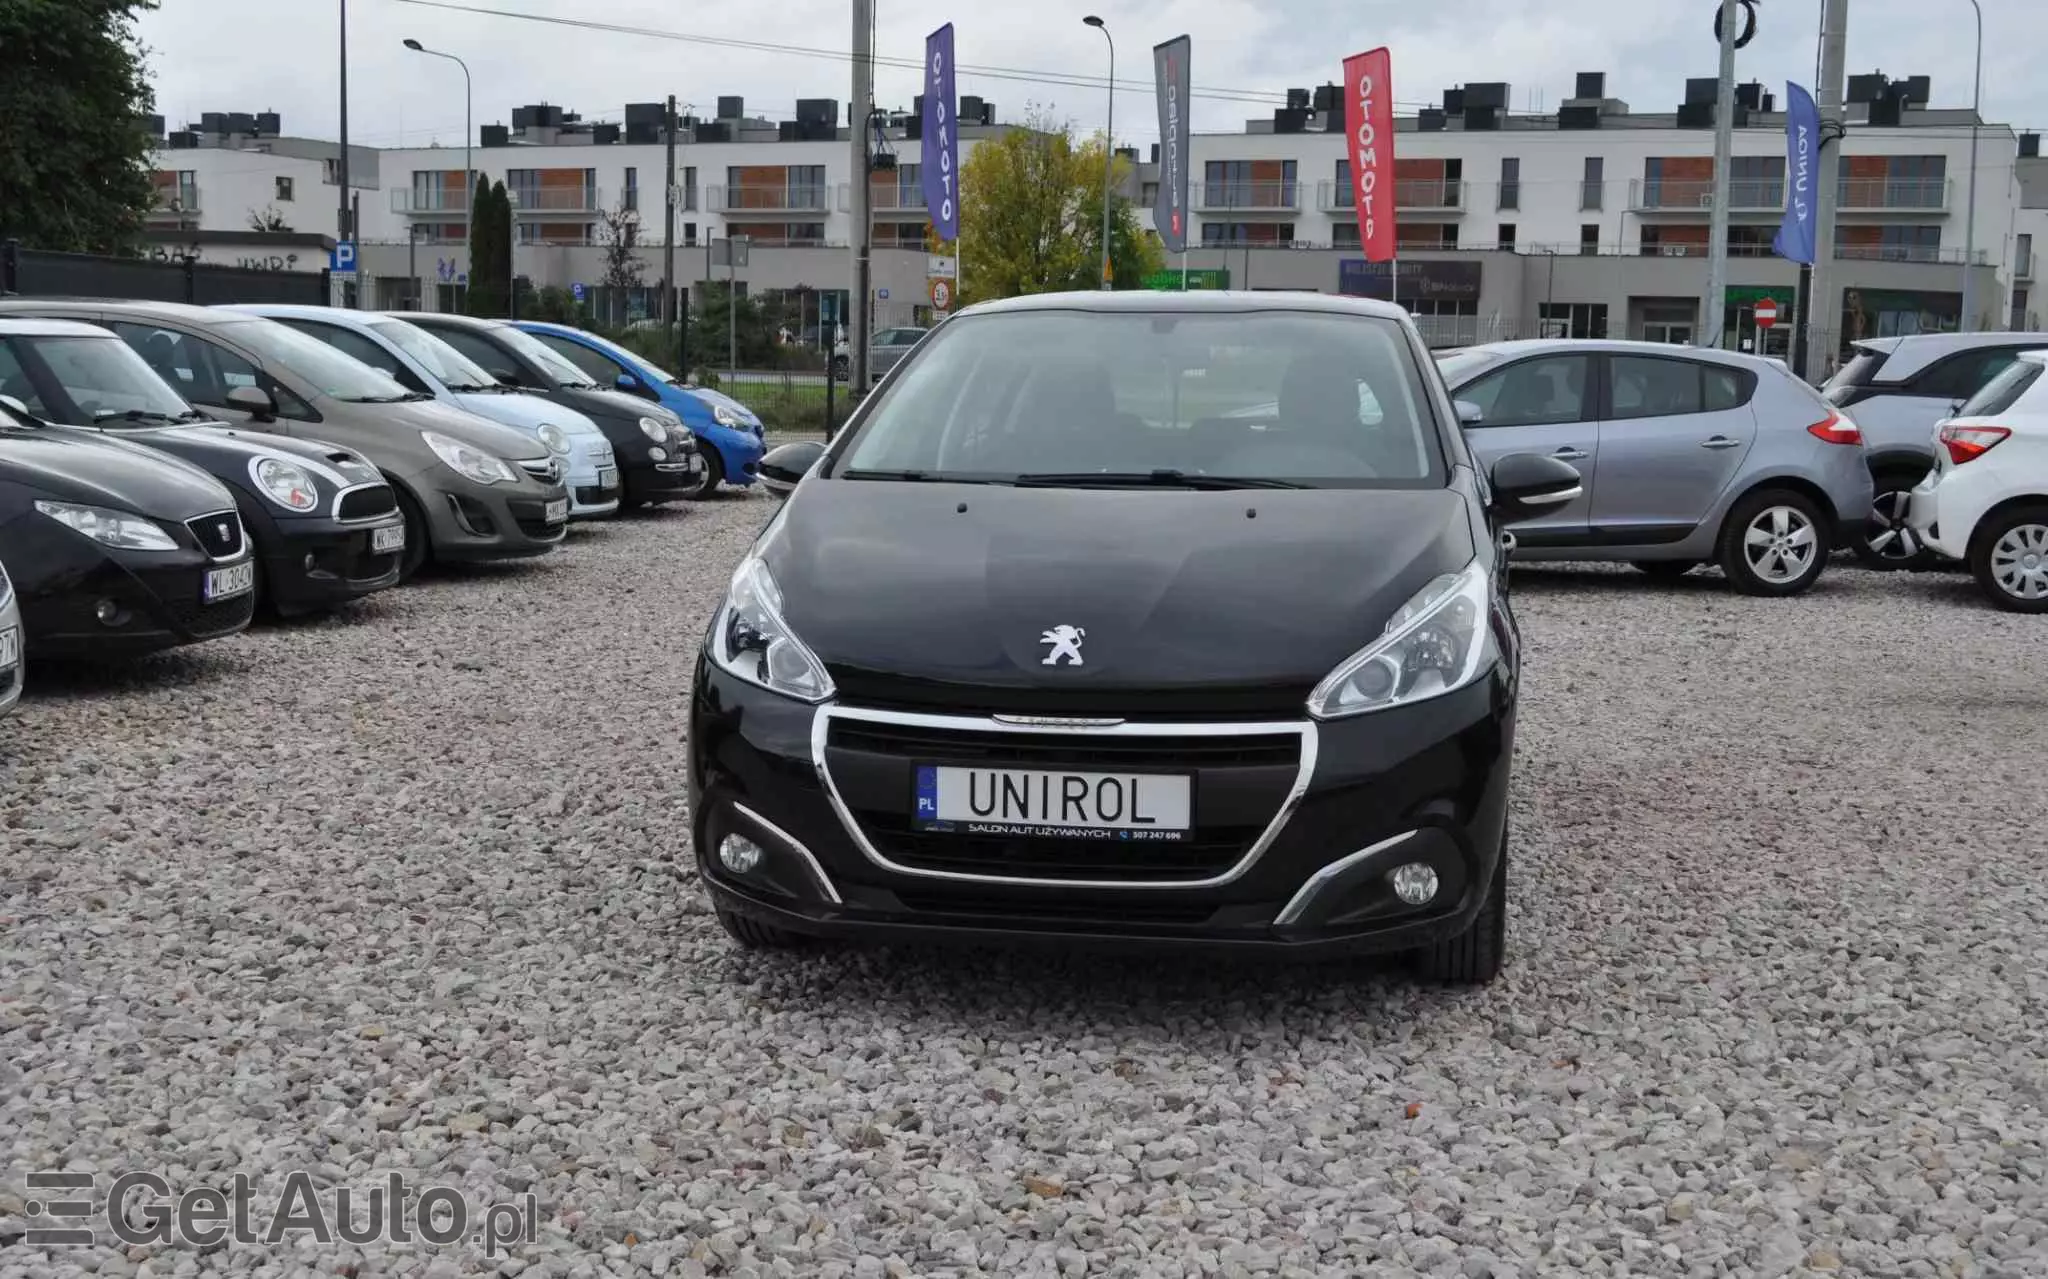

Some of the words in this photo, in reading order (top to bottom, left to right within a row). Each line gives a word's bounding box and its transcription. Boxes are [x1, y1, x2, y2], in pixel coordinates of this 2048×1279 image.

[933, 52, 951, 221] OTOMOTO
[1359, 75, 1377, 239] OTOMOTO
[336, 244, 353, 268] P
[919, 798, 935, 811] PL
[969, 772, 1156, 823] UNIROL
[968, 823, 1008, 833] SALON
[1009, 825, 1033, 834] AUT
